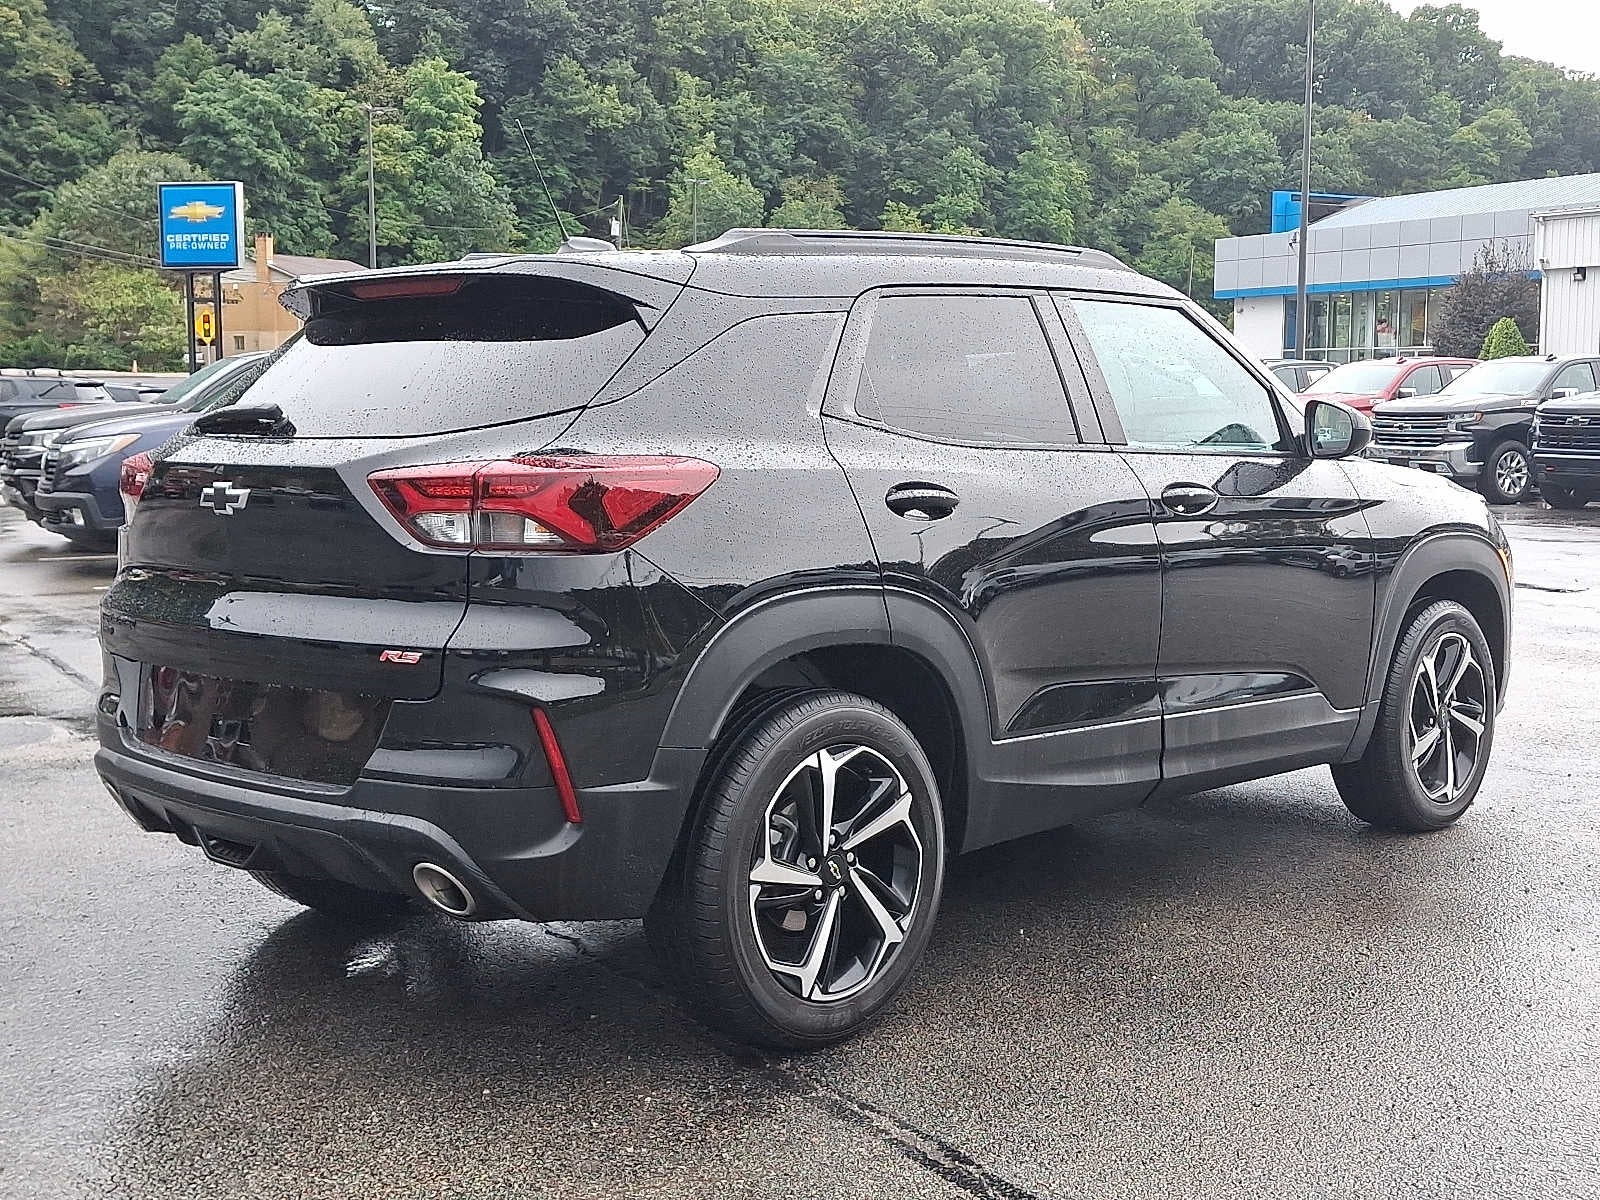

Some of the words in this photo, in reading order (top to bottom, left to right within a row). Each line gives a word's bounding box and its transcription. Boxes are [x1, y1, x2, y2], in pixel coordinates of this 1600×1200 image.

[166, 234, 229, 242] CERTIFIED
[169, 242, 227, 250] PRE-OWNED
[379, 650, 424, 664] RS
